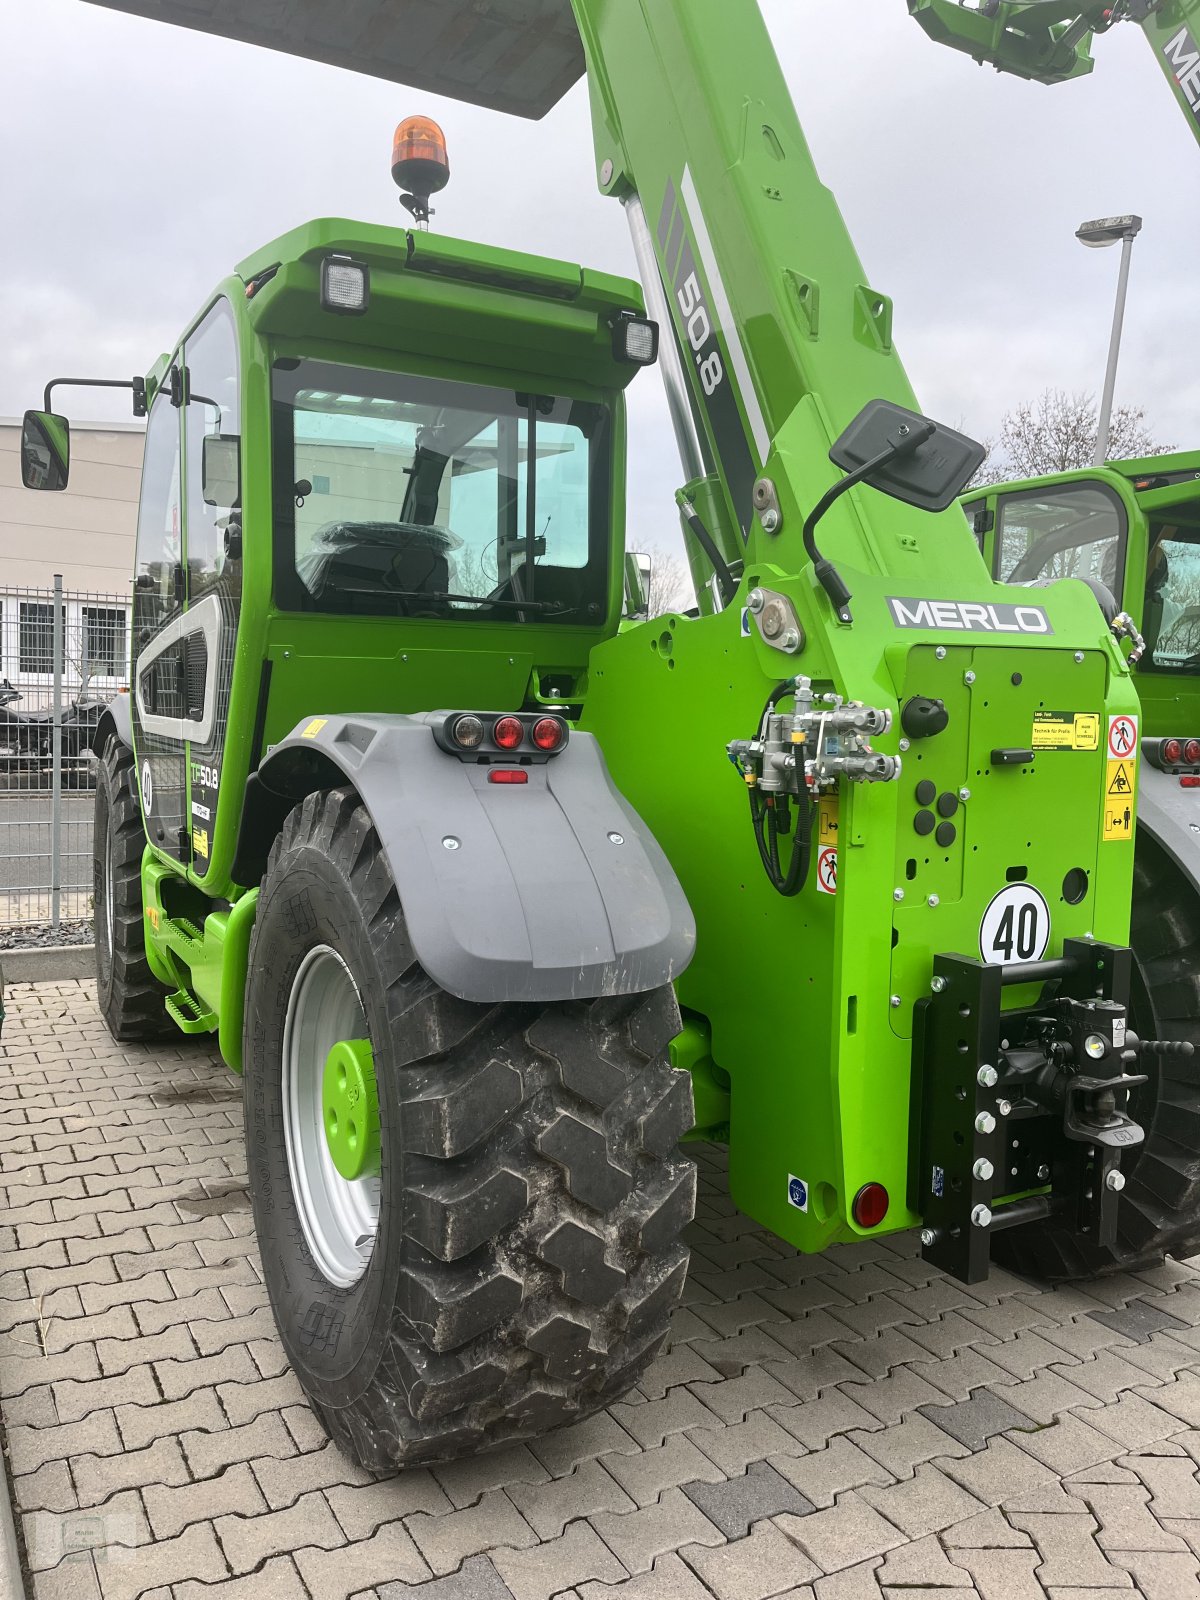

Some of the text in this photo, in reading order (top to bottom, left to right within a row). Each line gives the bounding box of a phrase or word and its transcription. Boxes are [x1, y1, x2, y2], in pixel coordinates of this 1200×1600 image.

[1163, 27, 1200, 113] ME
[677, 271, 723, 396] 50.8
[891, 599, 1048, 632] MERLO
[992, 902, 1038, 961] 40
